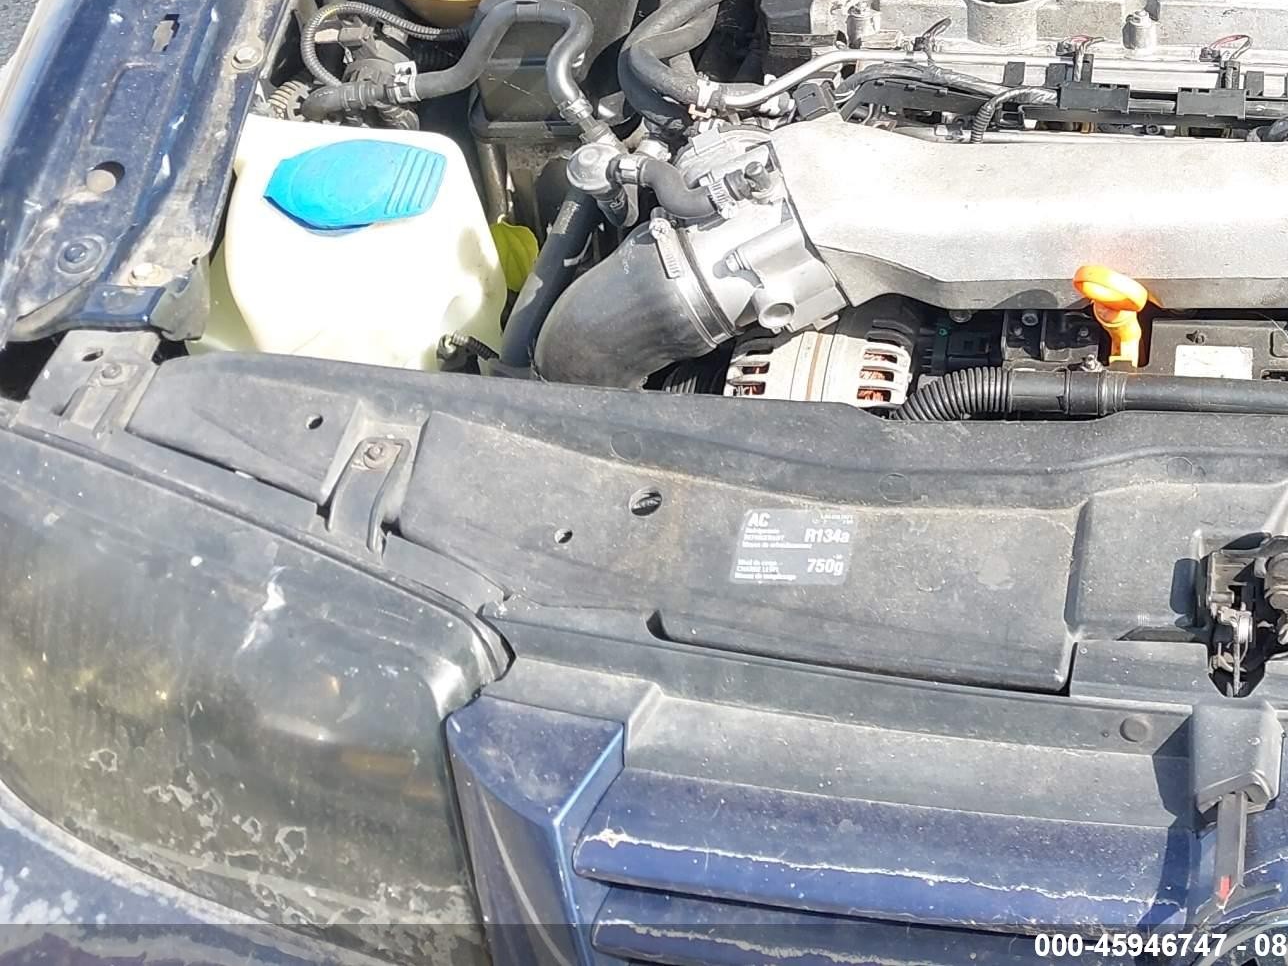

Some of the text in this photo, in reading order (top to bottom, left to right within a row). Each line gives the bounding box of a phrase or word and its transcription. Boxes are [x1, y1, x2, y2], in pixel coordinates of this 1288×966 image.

[748, 513, 770, 527] AC
[805, 528, 850, 543] R134a
[808, 558, 844, 576] 750g
